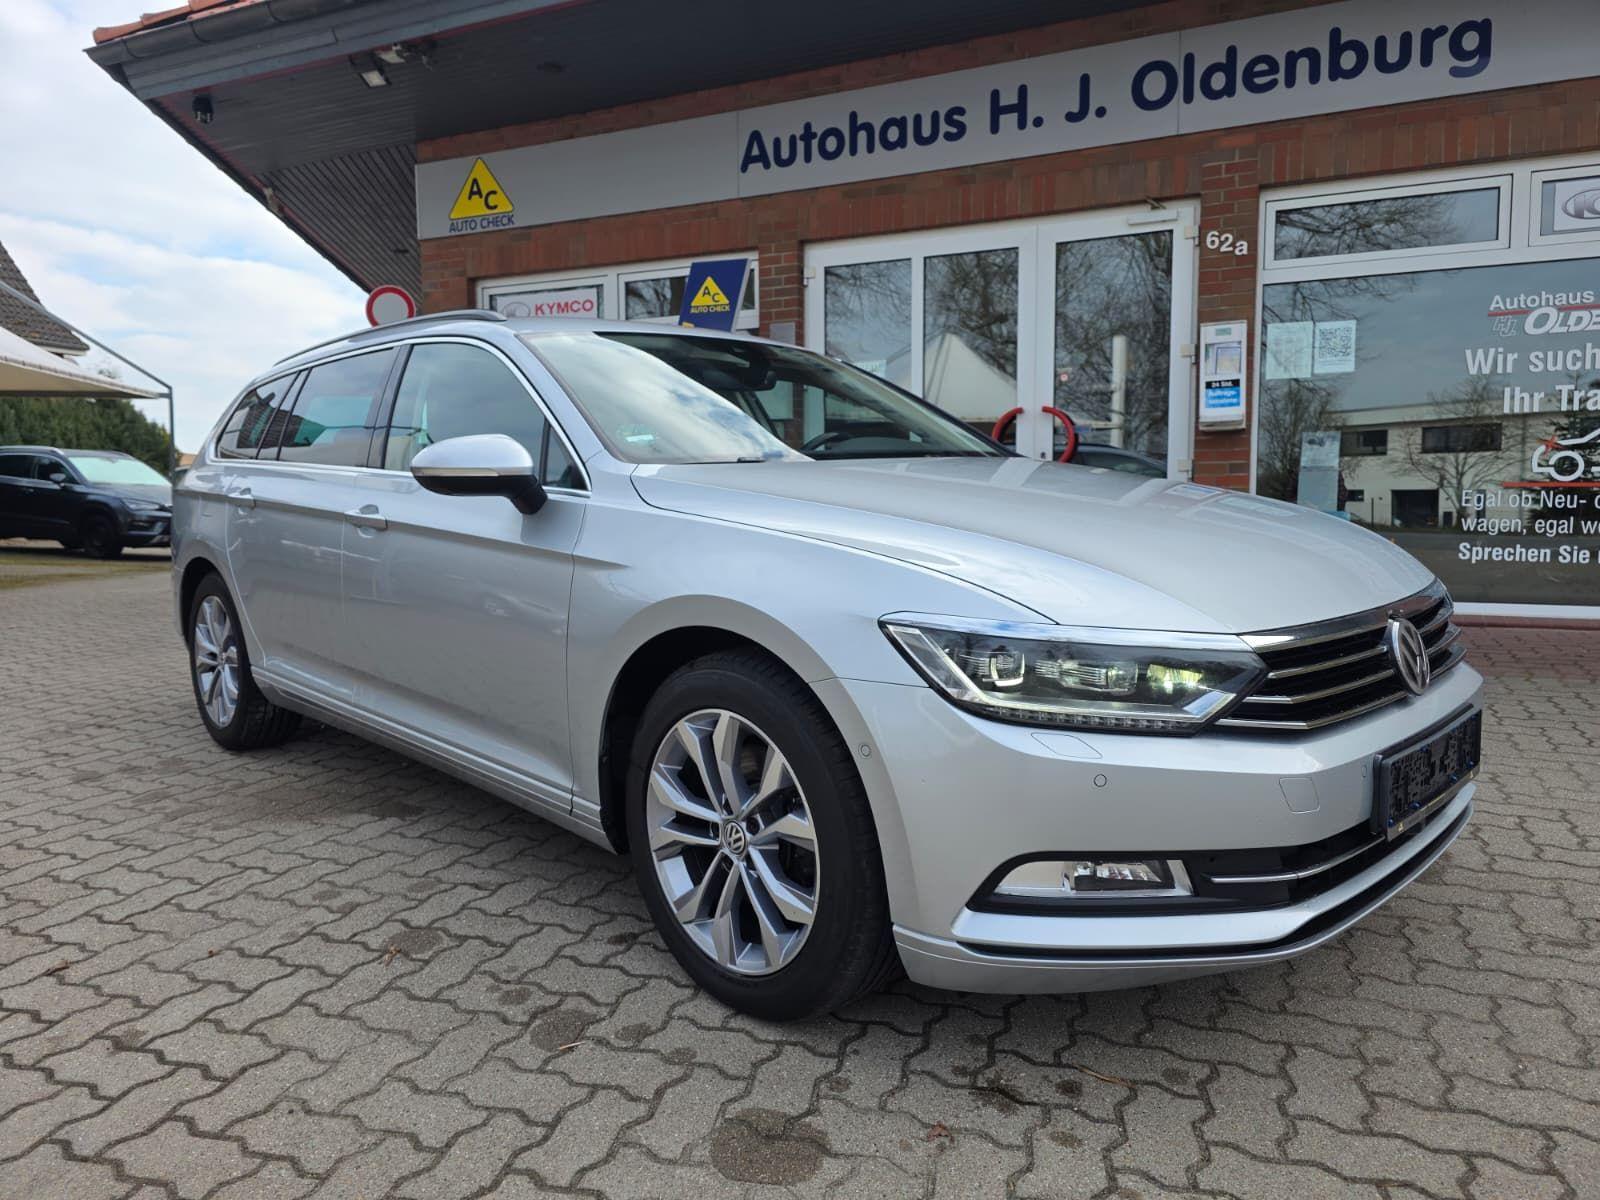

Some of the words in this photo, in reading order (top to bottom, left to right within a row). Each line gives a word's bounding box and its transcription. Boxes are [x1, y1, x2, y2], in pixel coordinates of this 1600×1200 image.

[740, 105, 967, 174] Autohaus
[989, 83, 1044, 135] H.
[1064, 72, 1107, 123] J.
[1131, 17, 1493, 112] Oldenburg
[448, 219, 477, 233] AUTO
[480, 213, 515, 229] CHECK
[1206, 231, 1248, 256] 62a
[535, 299, 594, 316] KYMCO
[1489, 290, 1595, 312] Autohaus
[1464, 347, 1519, 375] Wir
[1503, 386, 1545, 414] Ihr
[1555, 384, 1600, 411] Tra
[1461, 489, 1501, 511] Egal
[1508, 490, 1532, 508] ob
[1540, 490, 1587, 509] Neu-
[1461, 518, 1527, 536] wagen,
[1534, 516, 1574, 537] egal
[1458, 542, 1551, 564] Sprechen
[1558, 545, 1590, 564] Sie
